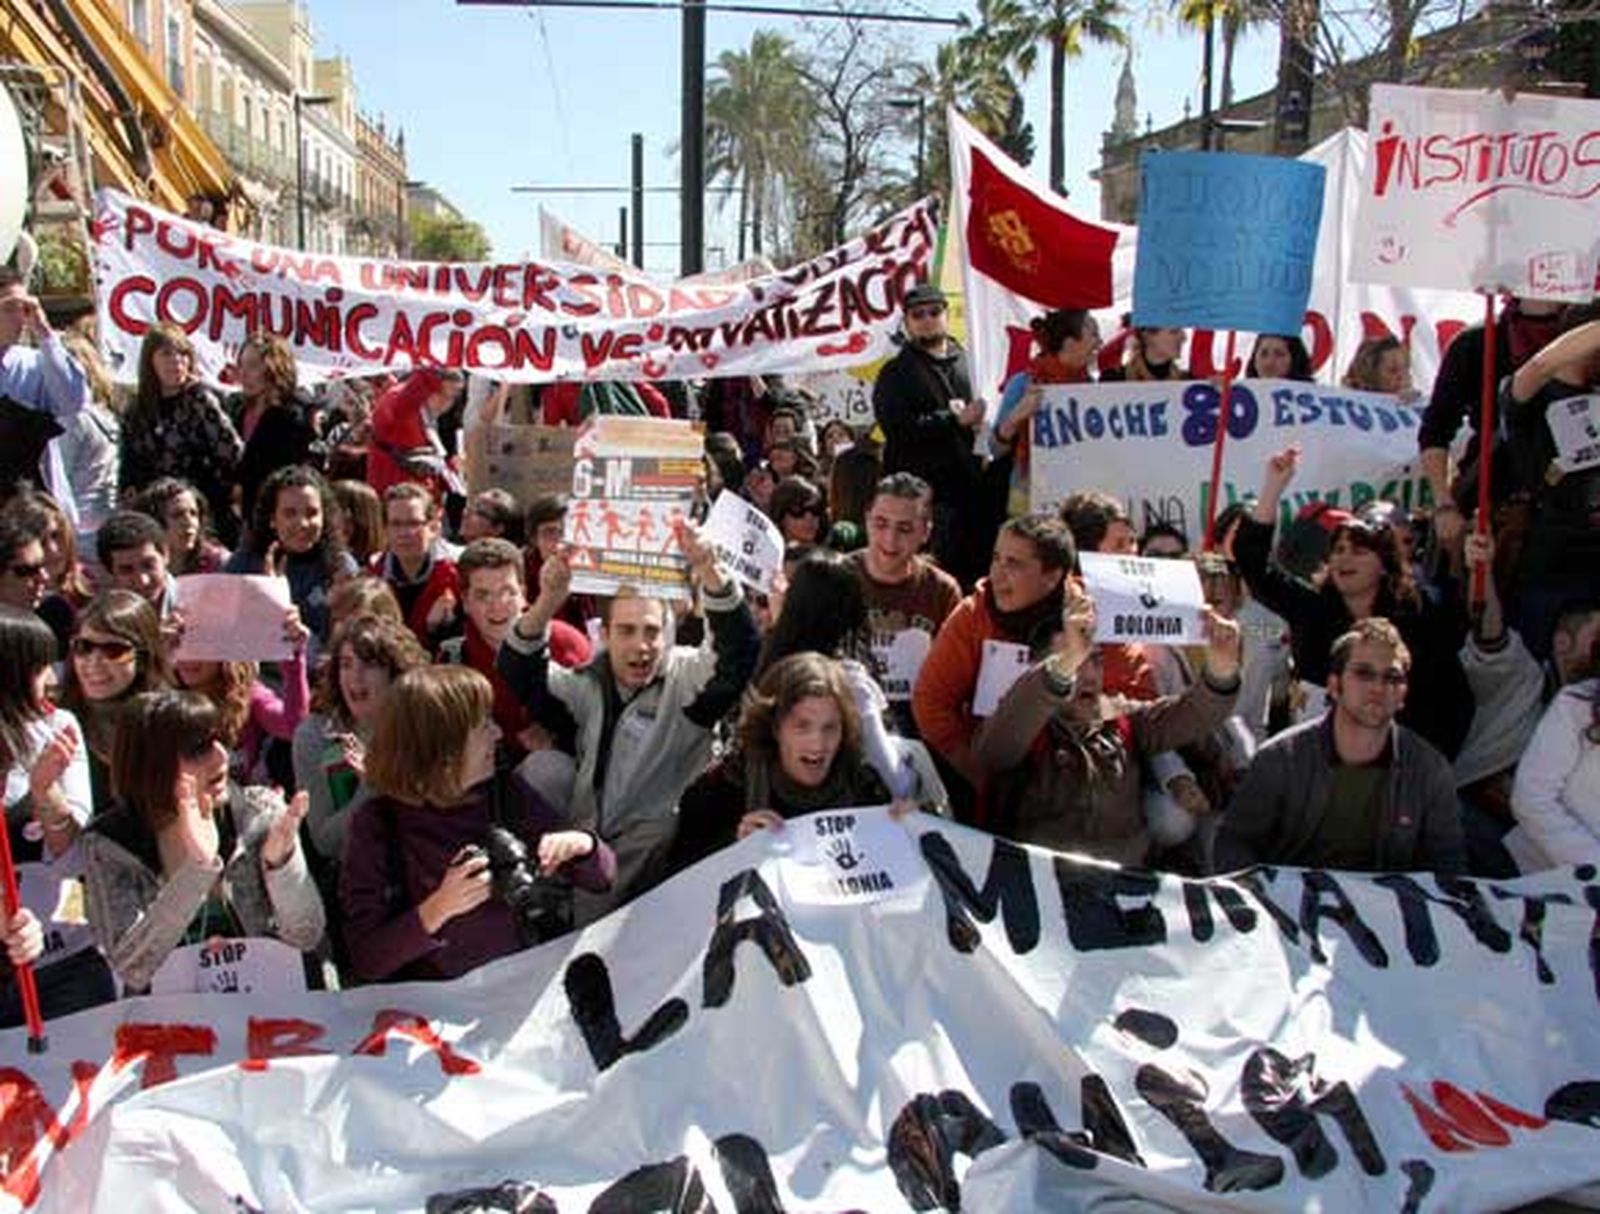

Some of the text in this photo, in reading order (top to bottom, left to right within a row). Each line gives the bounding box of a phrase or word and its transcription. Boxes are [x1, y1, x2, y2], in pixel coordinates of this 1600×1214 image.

[125, 206, 224, 273] POR
[251, 248, 343, 286] UNA
[1033, 398, 1170, 449] ANOCHE
[1181, 383, 1259, 447] 80
[1114, 614, 1182, 636] BOLONIA
[814, 815, 856, 837] STOP
[200, 943, 247, 968] STOP
